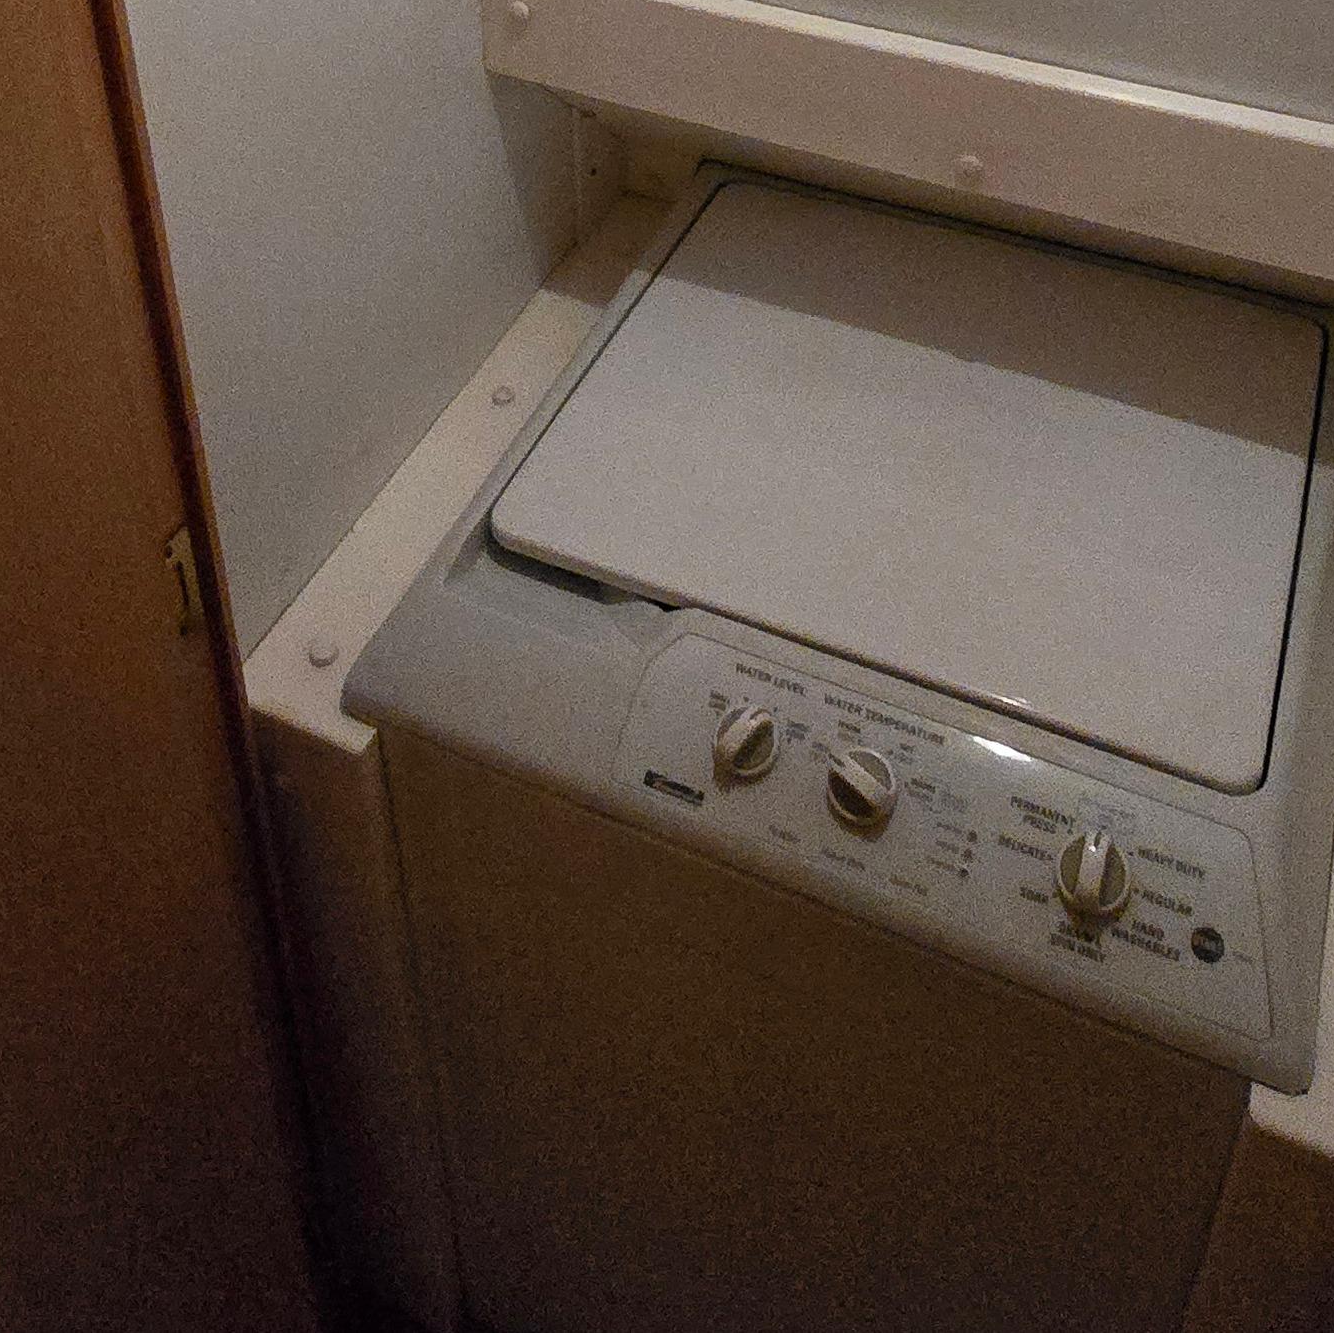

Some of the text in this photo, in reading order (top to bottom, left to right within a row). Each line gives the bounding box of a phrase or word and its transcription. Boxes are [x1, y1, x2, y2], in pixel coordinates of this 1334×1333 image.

[735, 662, 808, 698] WATER LEVEL
[824, 693, 864, 716] WATER
[865, 707, 946, 746] TEMPERATURE
[1010, 796, 1076, 827] PERMANENT
[1023, 815, 1057, 834] PRESS
[998, 832, 1047, 860] DELICATE
[1138, 847, 1205, 879] HEAVY DUTY
[1141, 889, 1194, 917] REGULAR
[1112, 926, 1182, 963] WASHABLES
[1132, 918, 1166, 942] HAND
